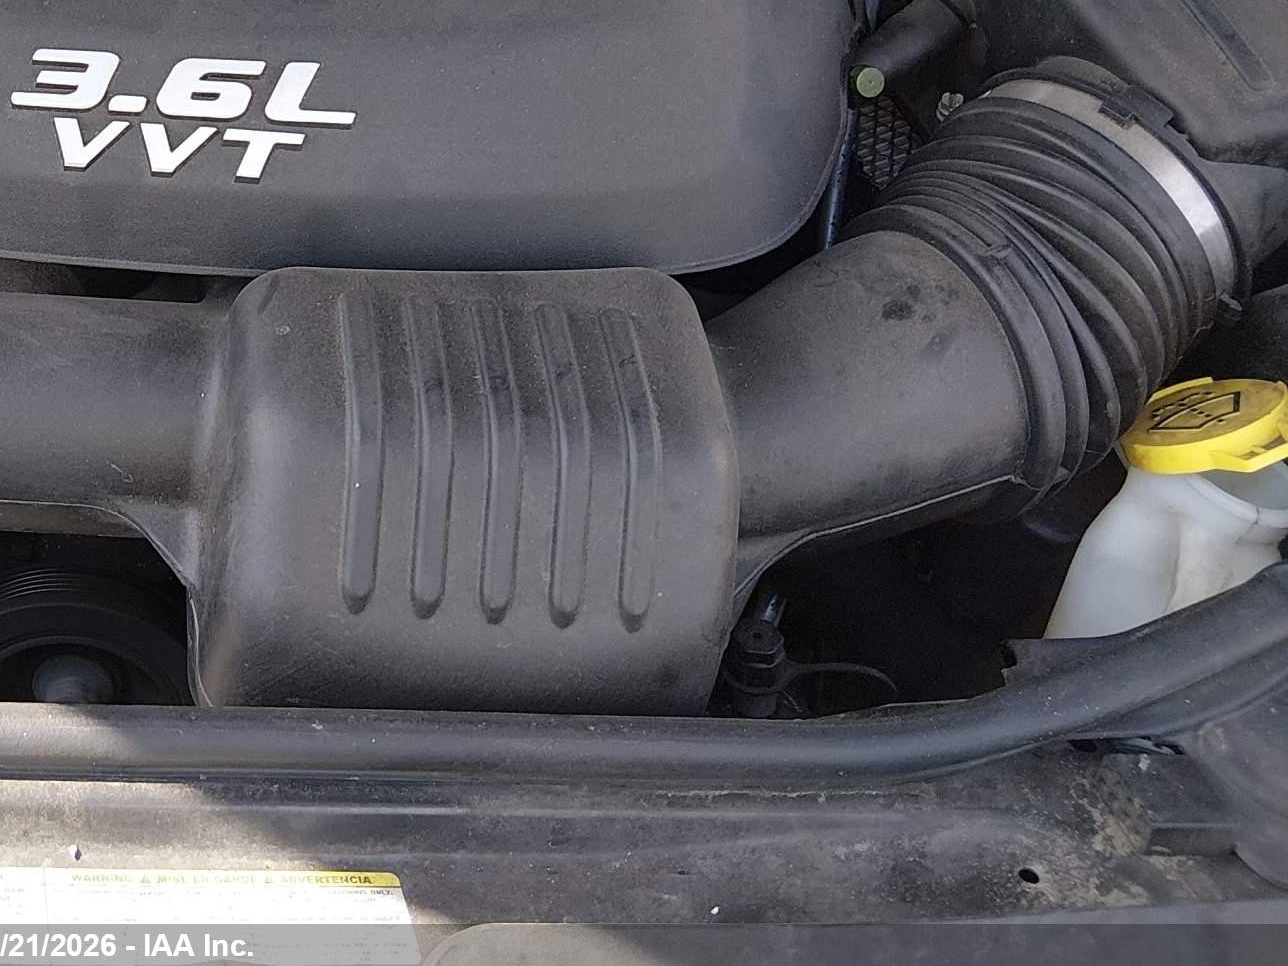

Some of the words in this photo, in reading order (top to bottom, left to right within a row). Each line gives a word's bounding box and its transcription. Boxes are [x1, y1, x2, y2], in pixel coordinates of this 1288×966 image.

[11, 47, 358, 129] 3.6L
[52, 116, 307, 183] VVT
[71, 873, 133, 883] WARNING
[280, 875, 373, 885] ADVERTENCIA
